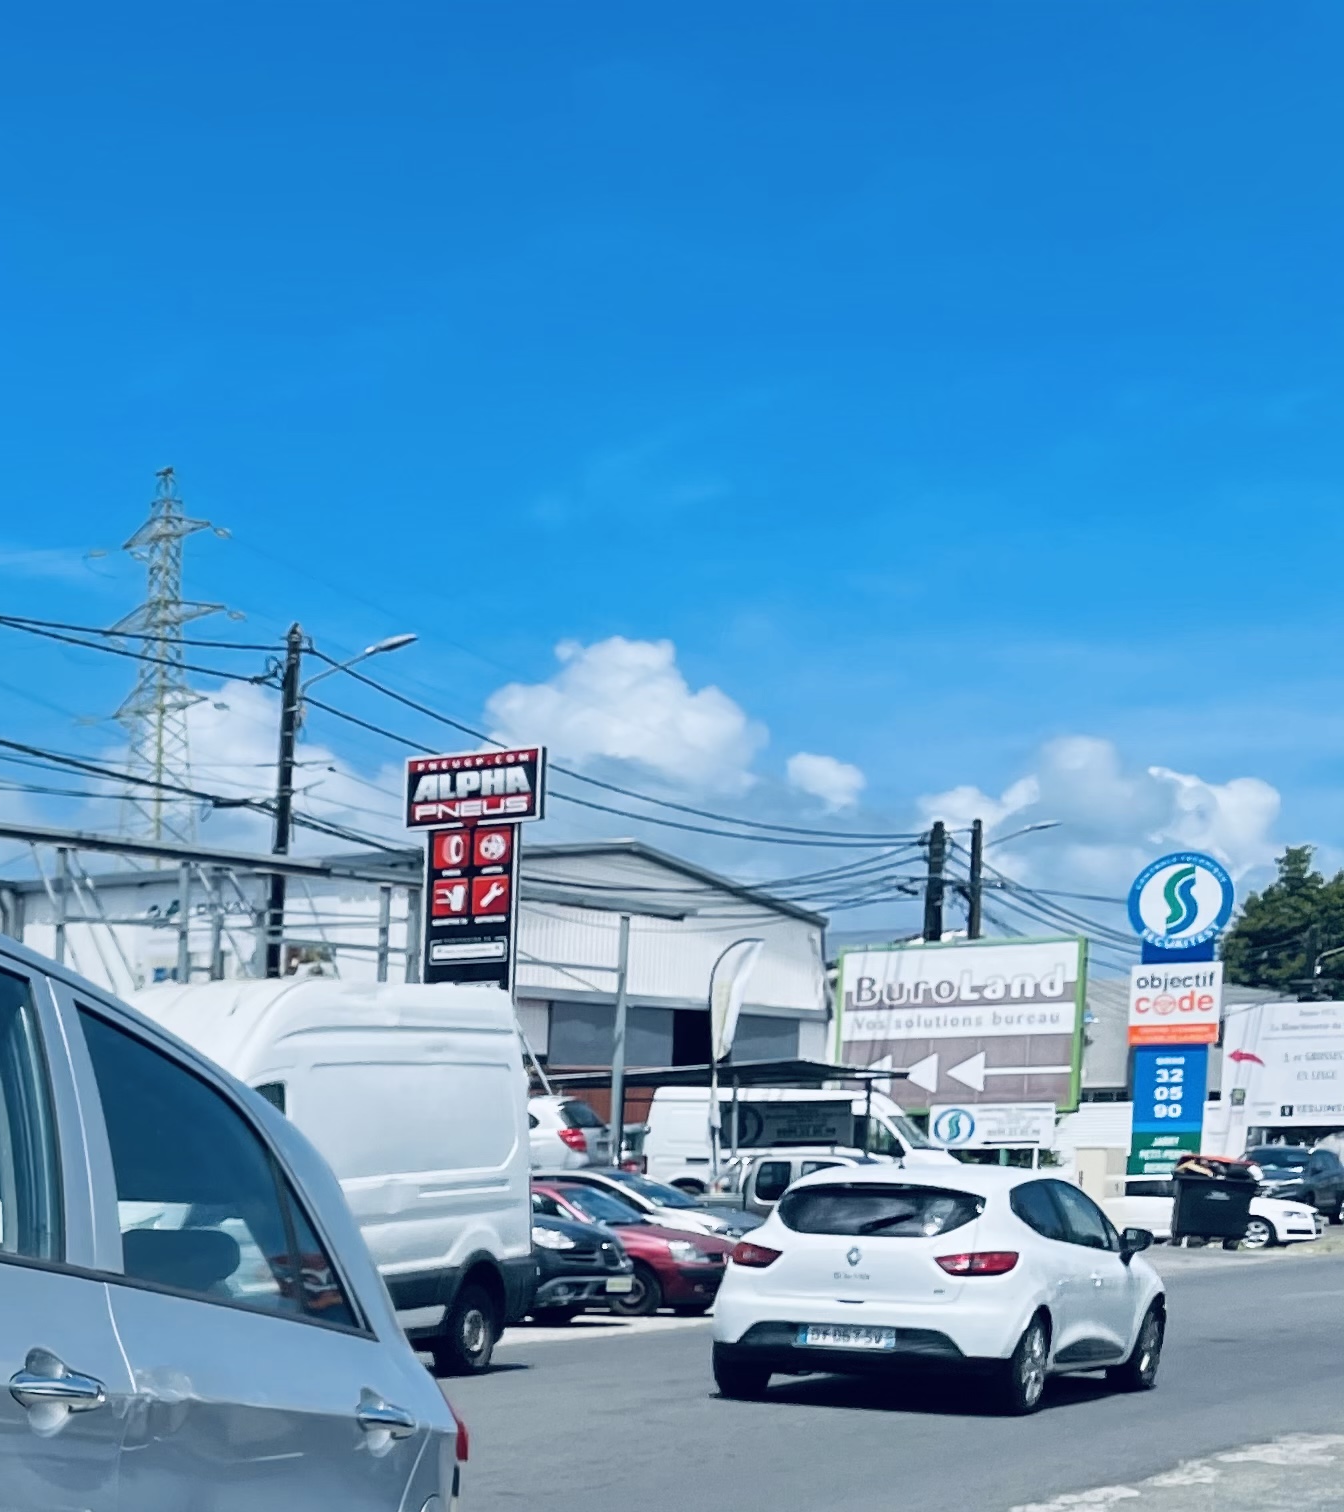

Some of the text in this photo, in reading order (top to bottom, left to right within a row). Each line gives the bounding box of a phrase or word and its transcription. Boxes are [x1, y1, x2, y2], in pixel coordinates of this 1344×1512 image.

[413, 765, 532, 803] ALPHA
[415, 795, 529, 821] PNEUS
[853, 962, 1067, 1007] BuroLand
[1136, 971, 1215, 992] objectif
[894, 1014, 983, 1030] solutions
[992, 1010, 1060, 1027] bureau
[1155, 1068, 1185, 1084] 32
[1153, 1085, 1184, 1101] 05
